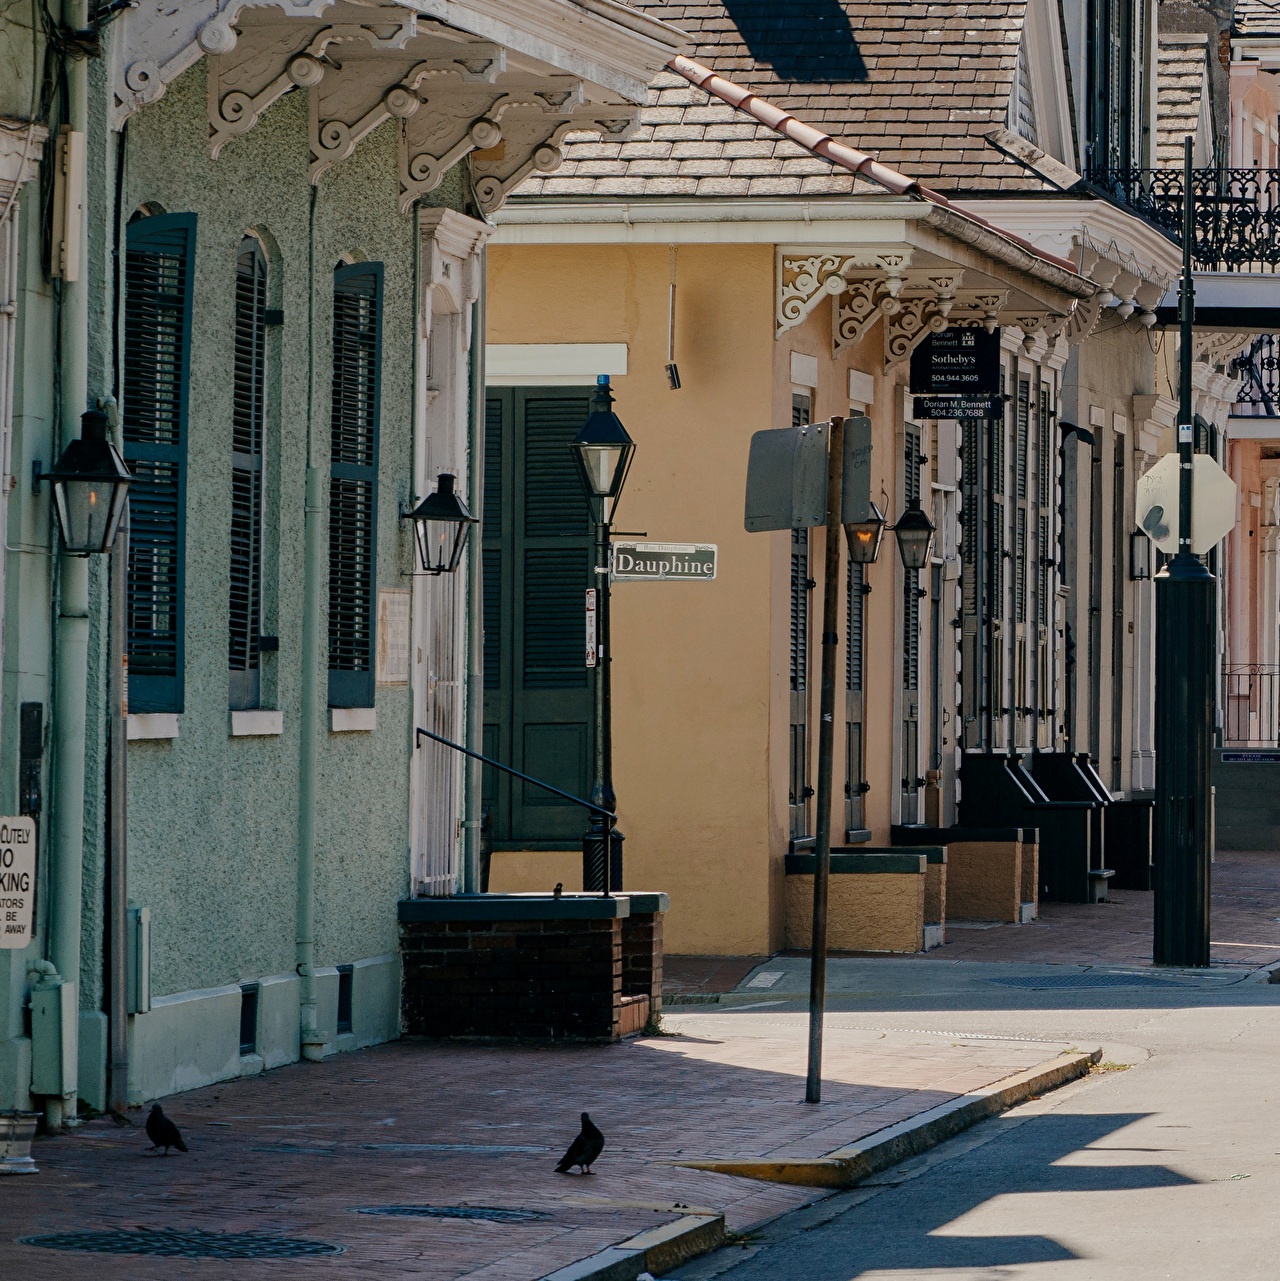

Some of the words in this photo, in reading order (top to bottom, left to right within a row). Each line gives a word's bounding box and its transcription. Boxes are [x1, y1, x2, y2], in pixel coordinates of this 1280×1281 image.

[931, 354, 976, 366] Sotheby's
[931, 374, 979, 382] 504.944.3605
[923, 400, 949, 408] Dorian
[961, 401, 991, 409] Bennett
[931, 409, 984, 417] 504.236.7688
[617, 553, 713, 575] Dauphine
[6, 911, 17, 922] BE
[4, 924, 27, 934] AWAY
